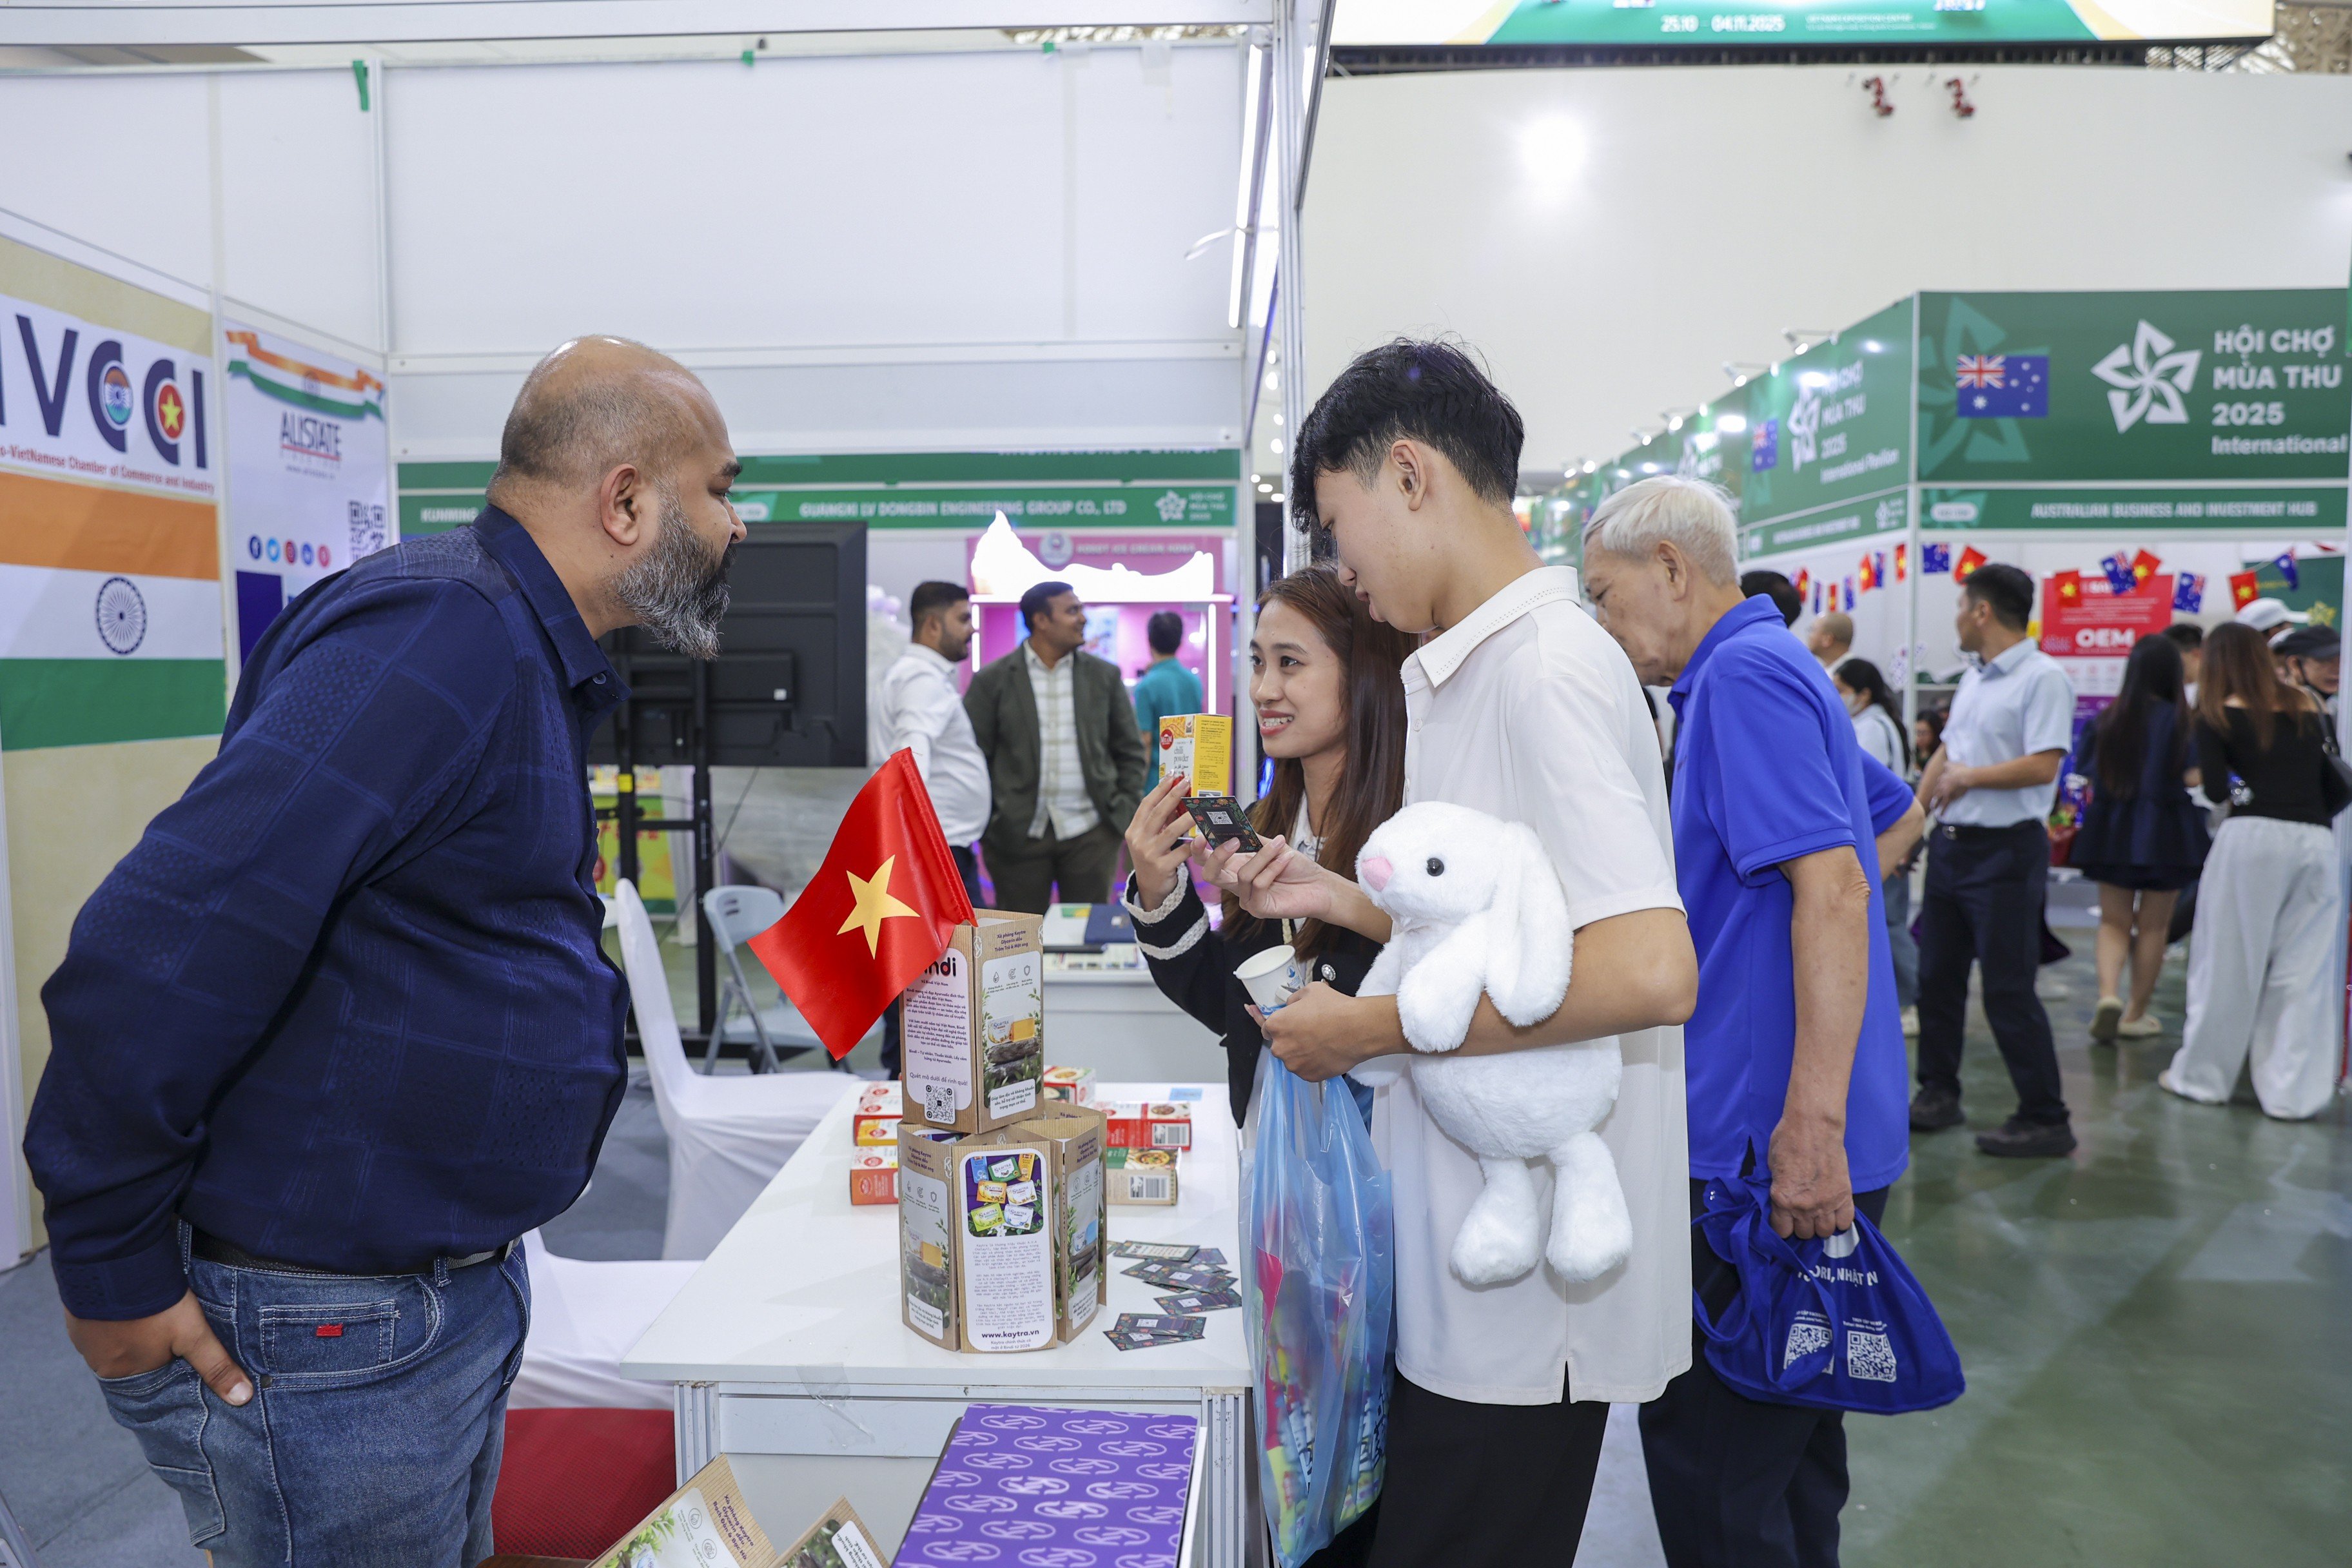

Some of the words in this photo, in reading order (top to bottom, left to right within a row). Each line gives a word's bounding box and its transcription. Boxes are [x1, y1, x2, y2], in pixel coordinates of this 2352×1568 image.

[2214, 324, 2265, 360] HỘI
[2270, 324, 2335, 358] CHỢ
[2213, 360, 2277, 389] MÙA
[2282, 364, 2342, 388] THU
[0, 313, 208, 469] VCCI
[2211, 402, 2285, 426] 2025
[2211, 433, 2348, 455] International
[69, 456, 106, 475] Chamber
[111, 464, 118, 476] of
[122, 466, 161, 483] Commerce
[940, 500, 1024, 516] ENGINEERING
[1026, 500, 1073, 515] GROUP
[1102, 500, 1127, 515] LTD
[2031, 502, 2110, 518] AUSTRALIAN
[2112, 502, 2173, 518] BUSINESS
[2174, 502, 2204, 517] AND
[2206, 501, 2286, 517] INVESTMENT
[2287, 500, 2318, 517] HUB
[2075, 627, 2135, 648] OEM
[925, 957, 956, 977] ndi
[1837, 1267, 1864, 1287] NHẬT
[982, 1330, 1039, 1338] www.kaytra.vn
[713, 1501, 721, 1518] Bạch
[732, 1538, 740, 1551] Bạc
[740, 1550, 747, 1560] Hà
[722, 1507, 736, 1532] Glycerin
[736, 1533, 745, 1545] dầu
[724, 1494, 730, 1504] Xà
[728, 1505, 740, 1525] phòng
[740, 1525, 754, 1546] Kaytra
